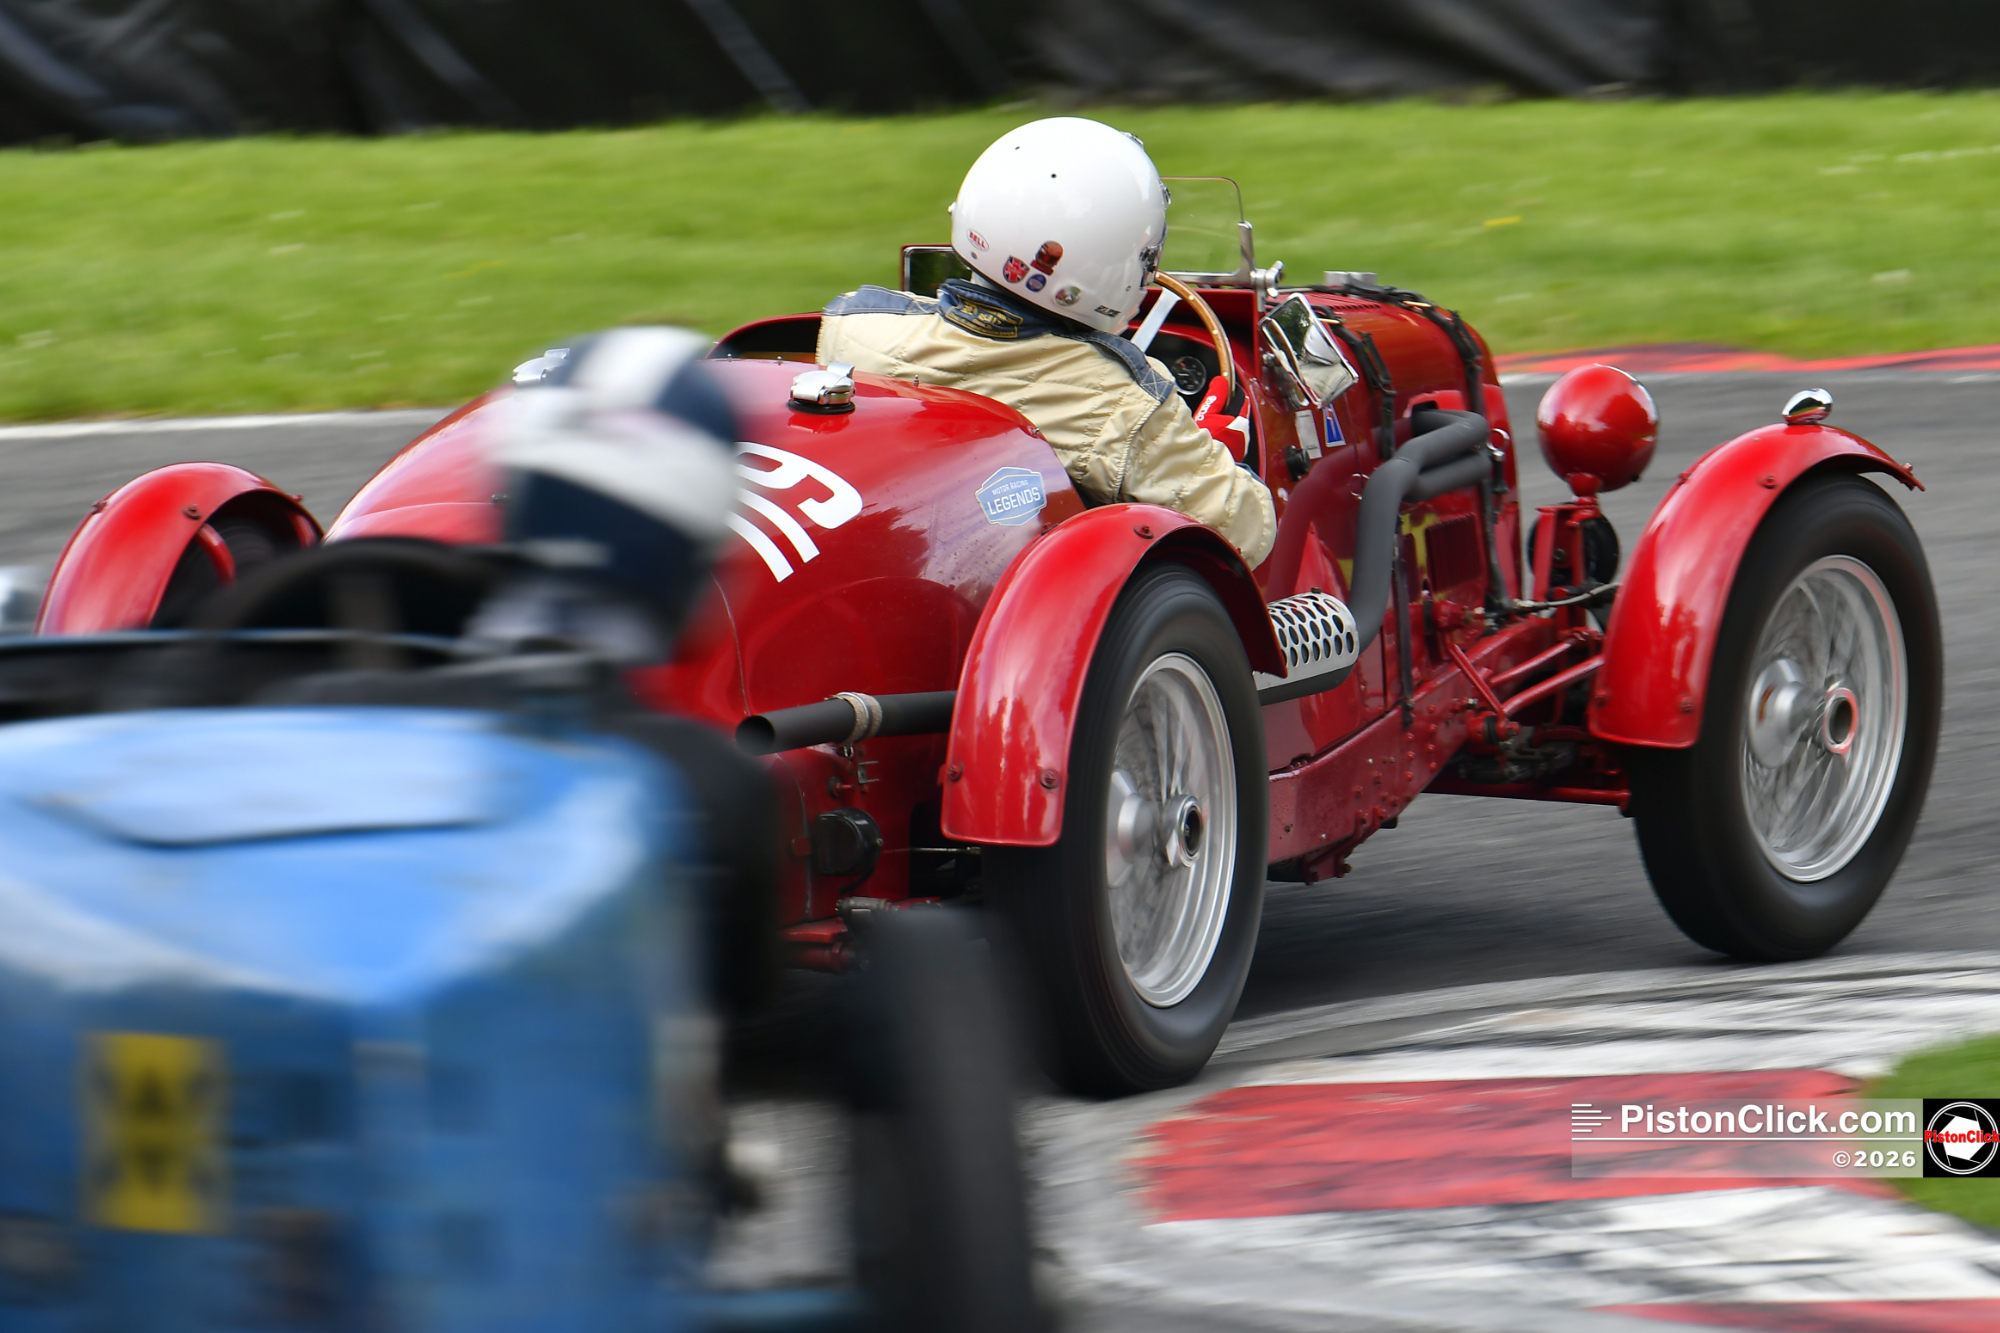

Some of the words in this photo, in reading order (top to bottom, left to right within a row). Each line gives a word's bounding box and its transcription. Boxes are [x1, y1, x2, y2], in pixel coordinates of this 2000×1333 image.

[969, 231, 986, 249] BELL
[992, 483, 1010, 495] MOTOR
[1009, 479, 1029, 490] RACING
[987, 487, 1041, 515] LEGENDS
